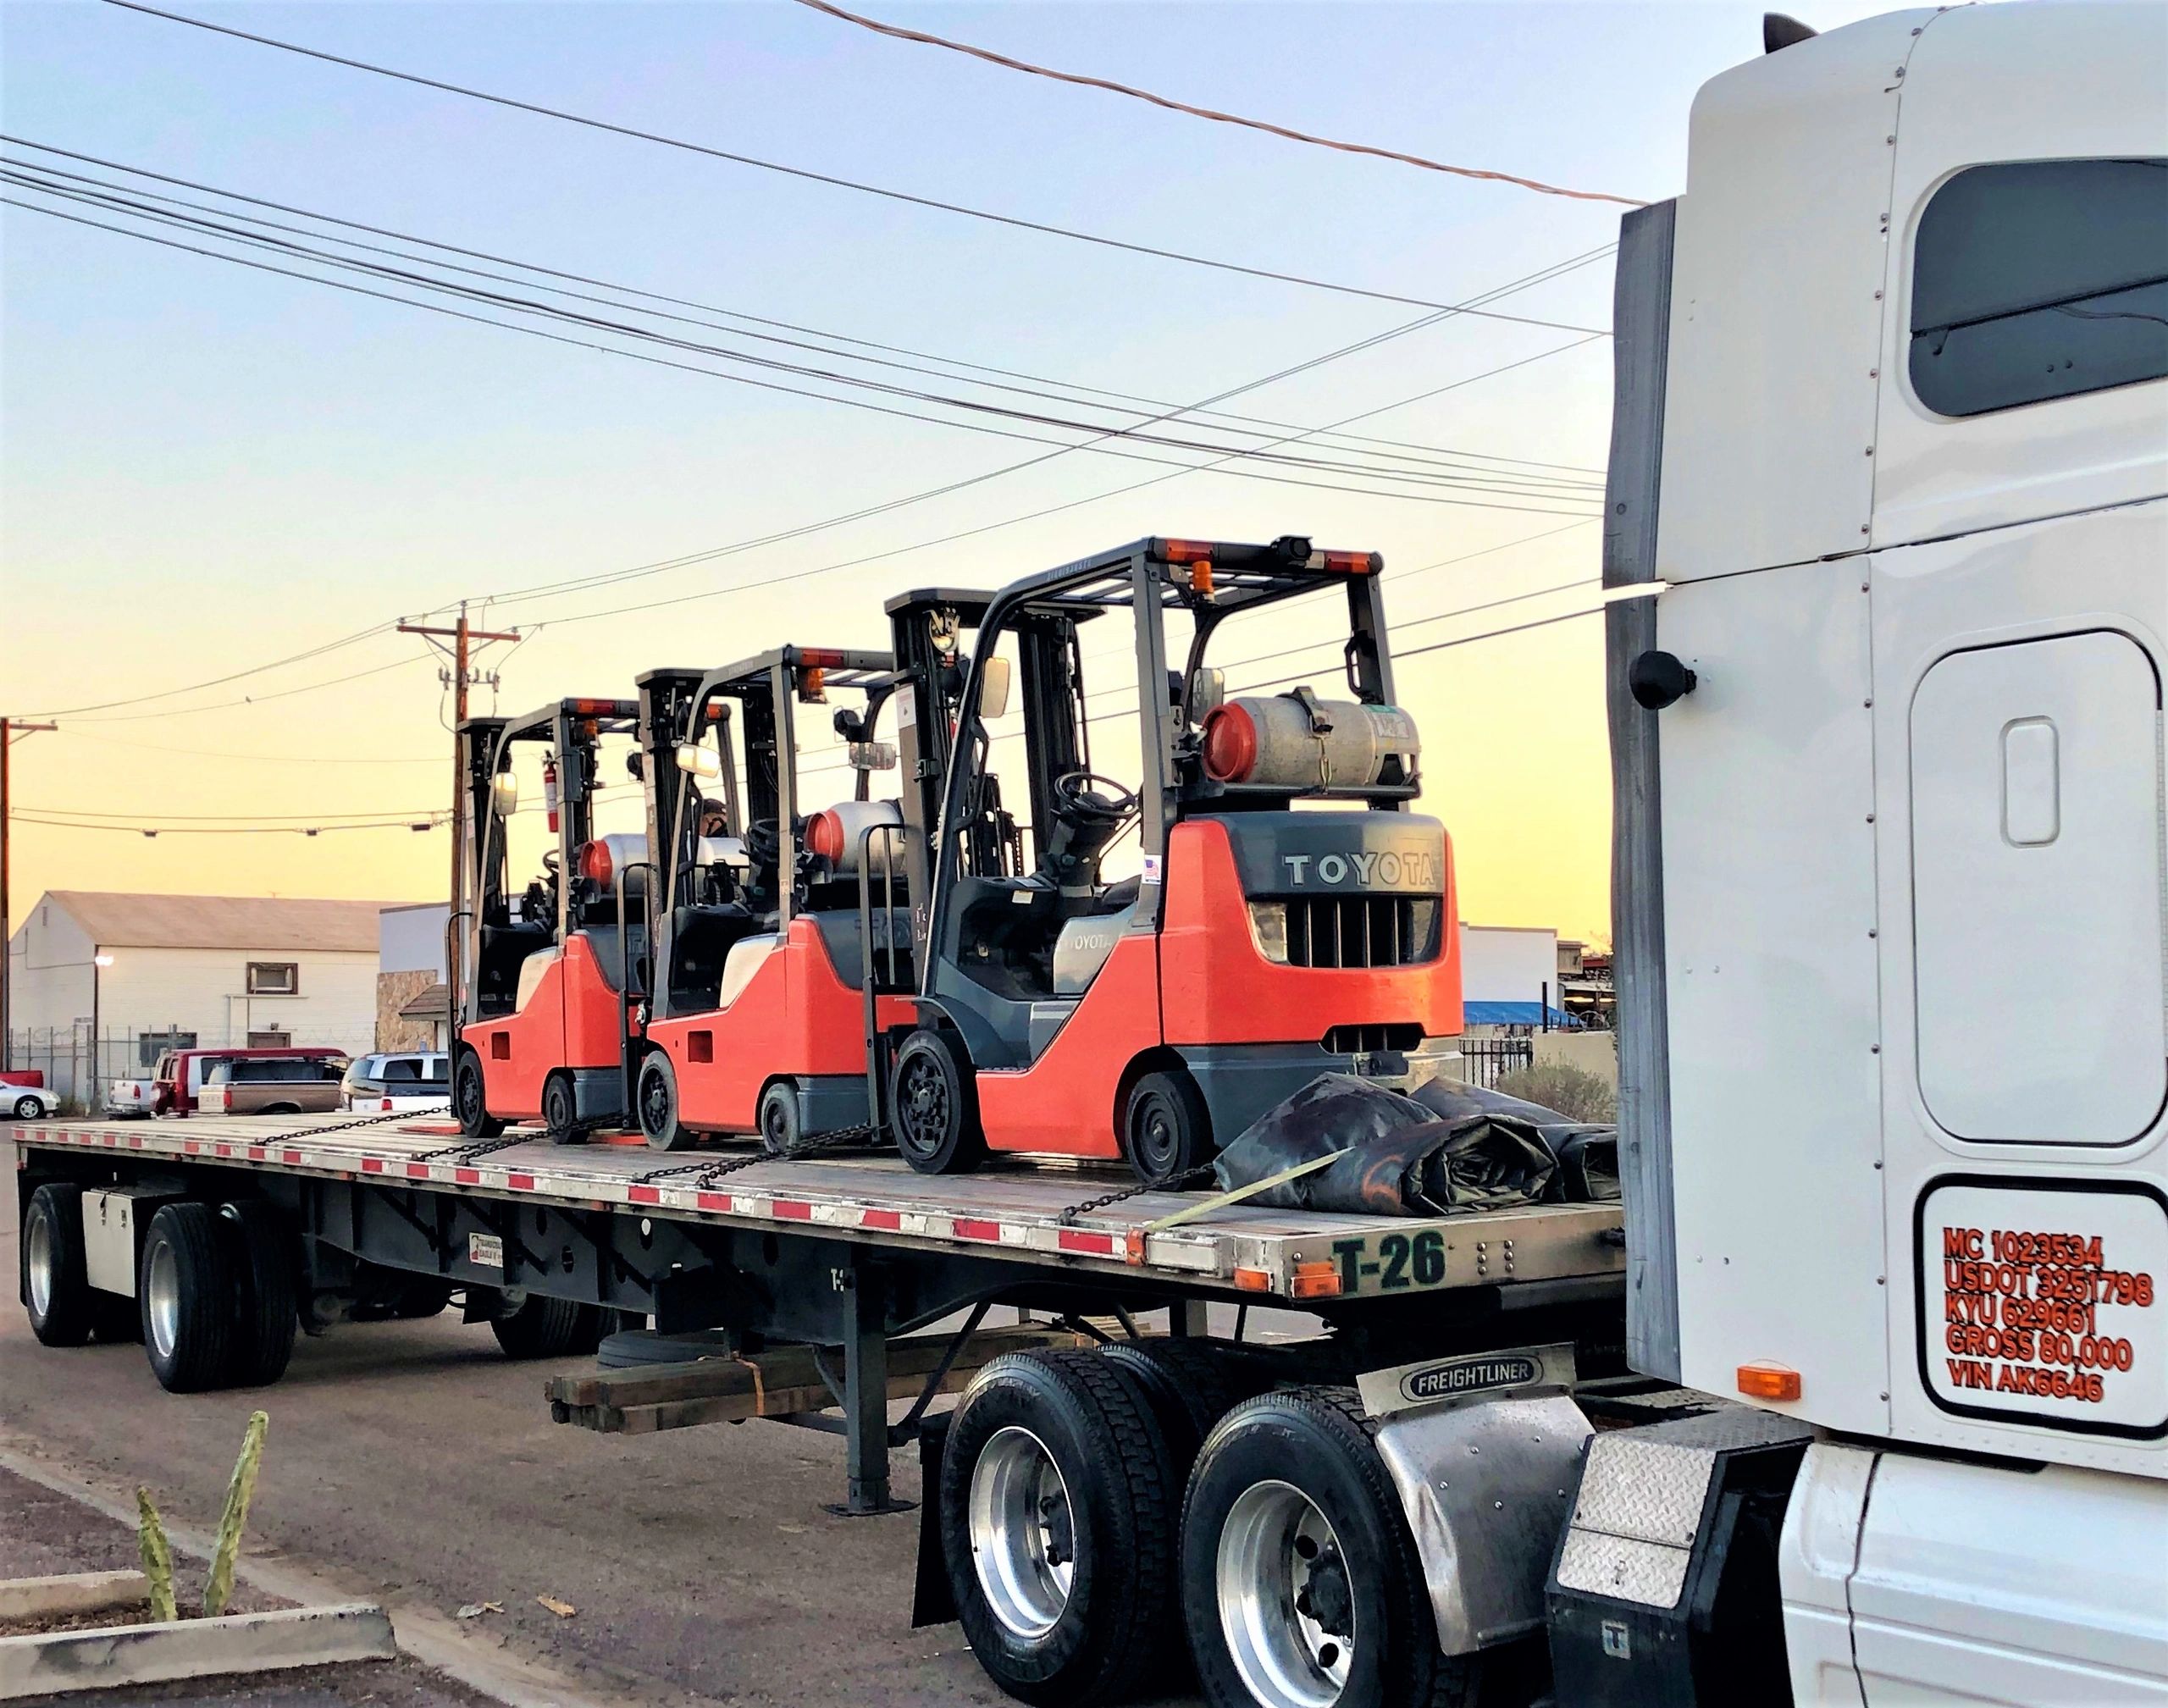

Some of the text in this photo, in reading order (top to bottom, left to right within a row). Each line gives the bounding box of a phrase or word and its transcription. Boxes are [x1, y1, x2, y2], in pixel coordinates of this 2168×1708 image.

[1284, 851, 1435, 886] TOYOTA
[1331, 1230, 1446, 1294] T-26
[1943, 1227, 2104, 1269] MC 1023534
[1944, 1258, 2154, 1307] USDOT 3251798
[1944, 1291, 2096, 1335] KYU 629661
[1946, 1324, 2034, 1362] GROSS
[1417, 1361, 1529, 1394] FREIGHTLINER
[1946, 1357, 2104, 1403] VIN AK6646
[1606, 1625, 1624, 1649] T
